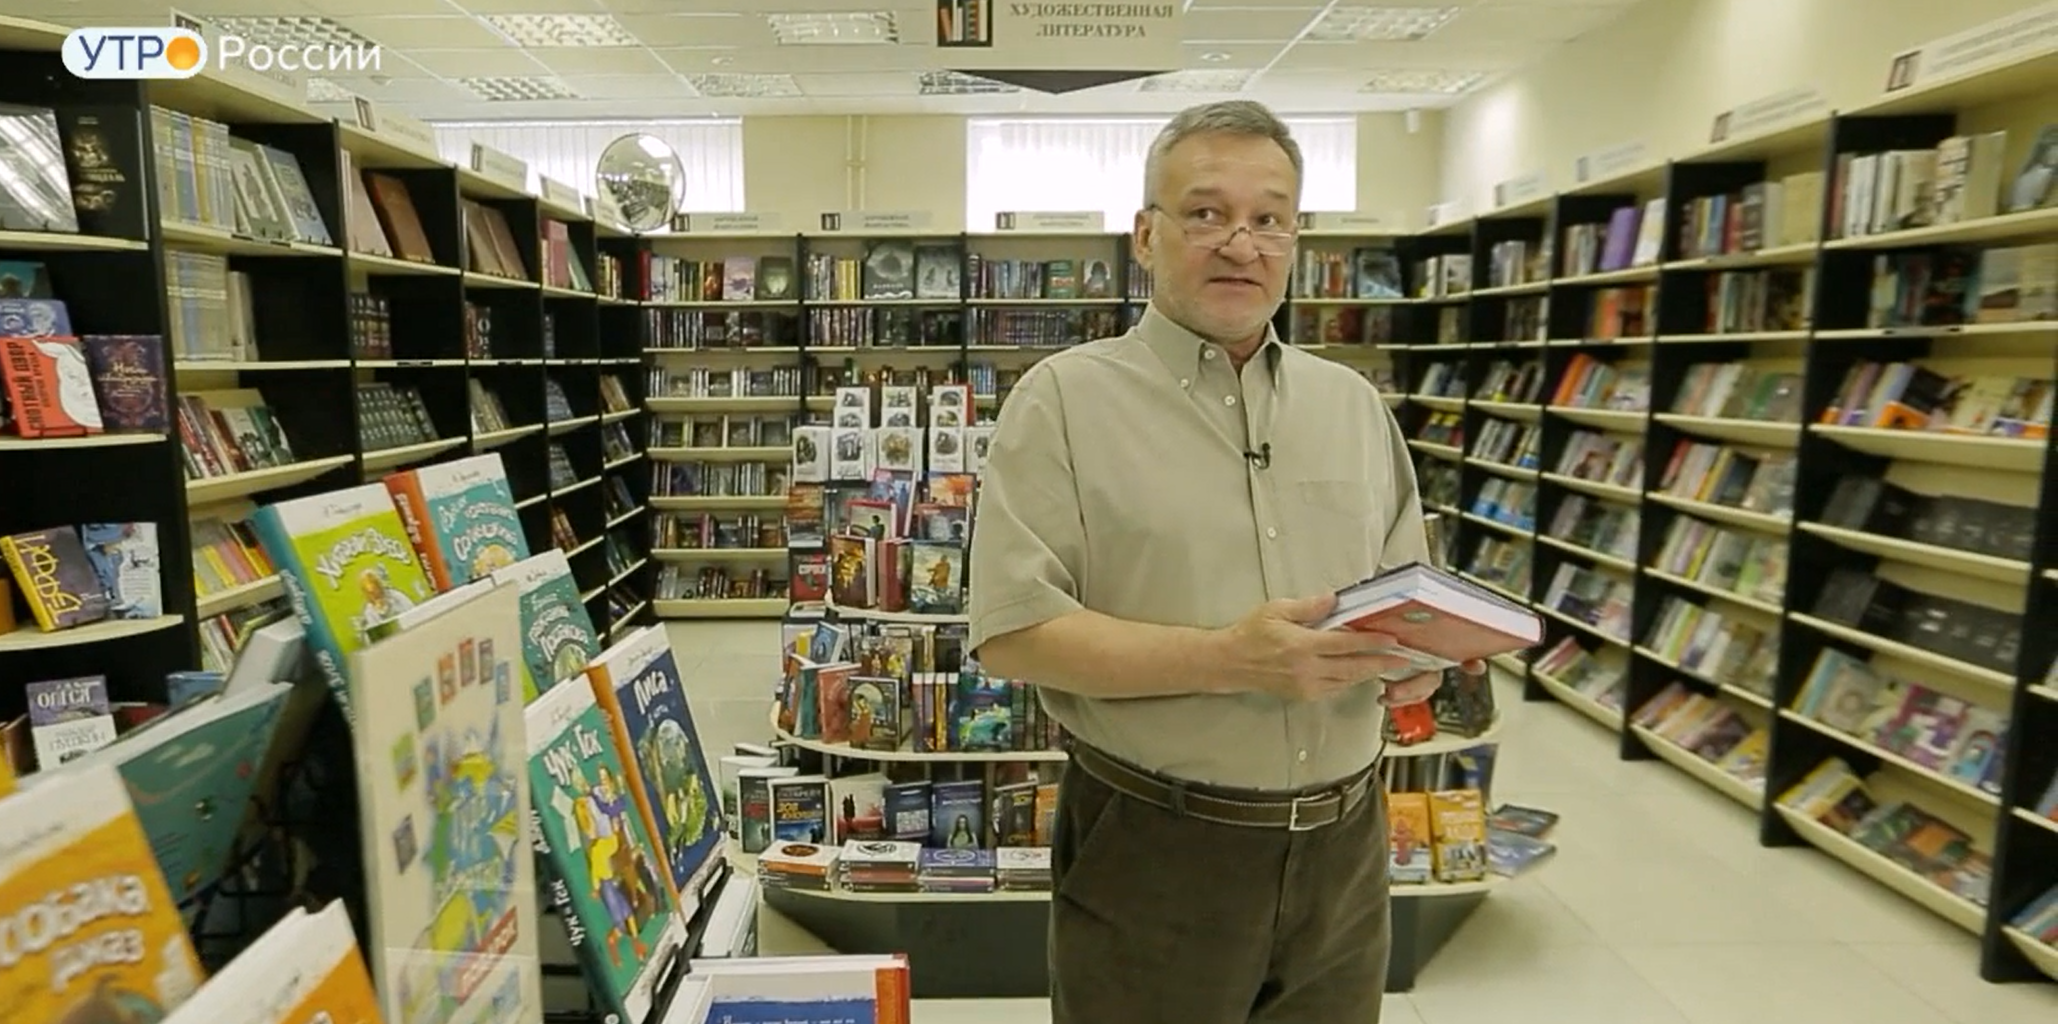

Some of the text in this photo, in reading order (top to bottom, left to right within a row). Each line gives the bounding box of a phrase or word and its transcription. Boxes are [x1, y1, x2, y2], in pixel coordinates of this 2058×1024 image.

[1010, 3, 1173, 19] ХУДОЖЕСТВЕННАЯ
[1036, 23, 1147, 38] ЛИТЕРАТУРА
[6, 341, 32, 373] ДВОР
[633, 670, 669, 715] Лиса
[542, 741, 578, 787] Чук
[574, 723, 604, 760] Гек
[551, 878, 571, 906] Гек
[565, 914, 586, 947] Чук
